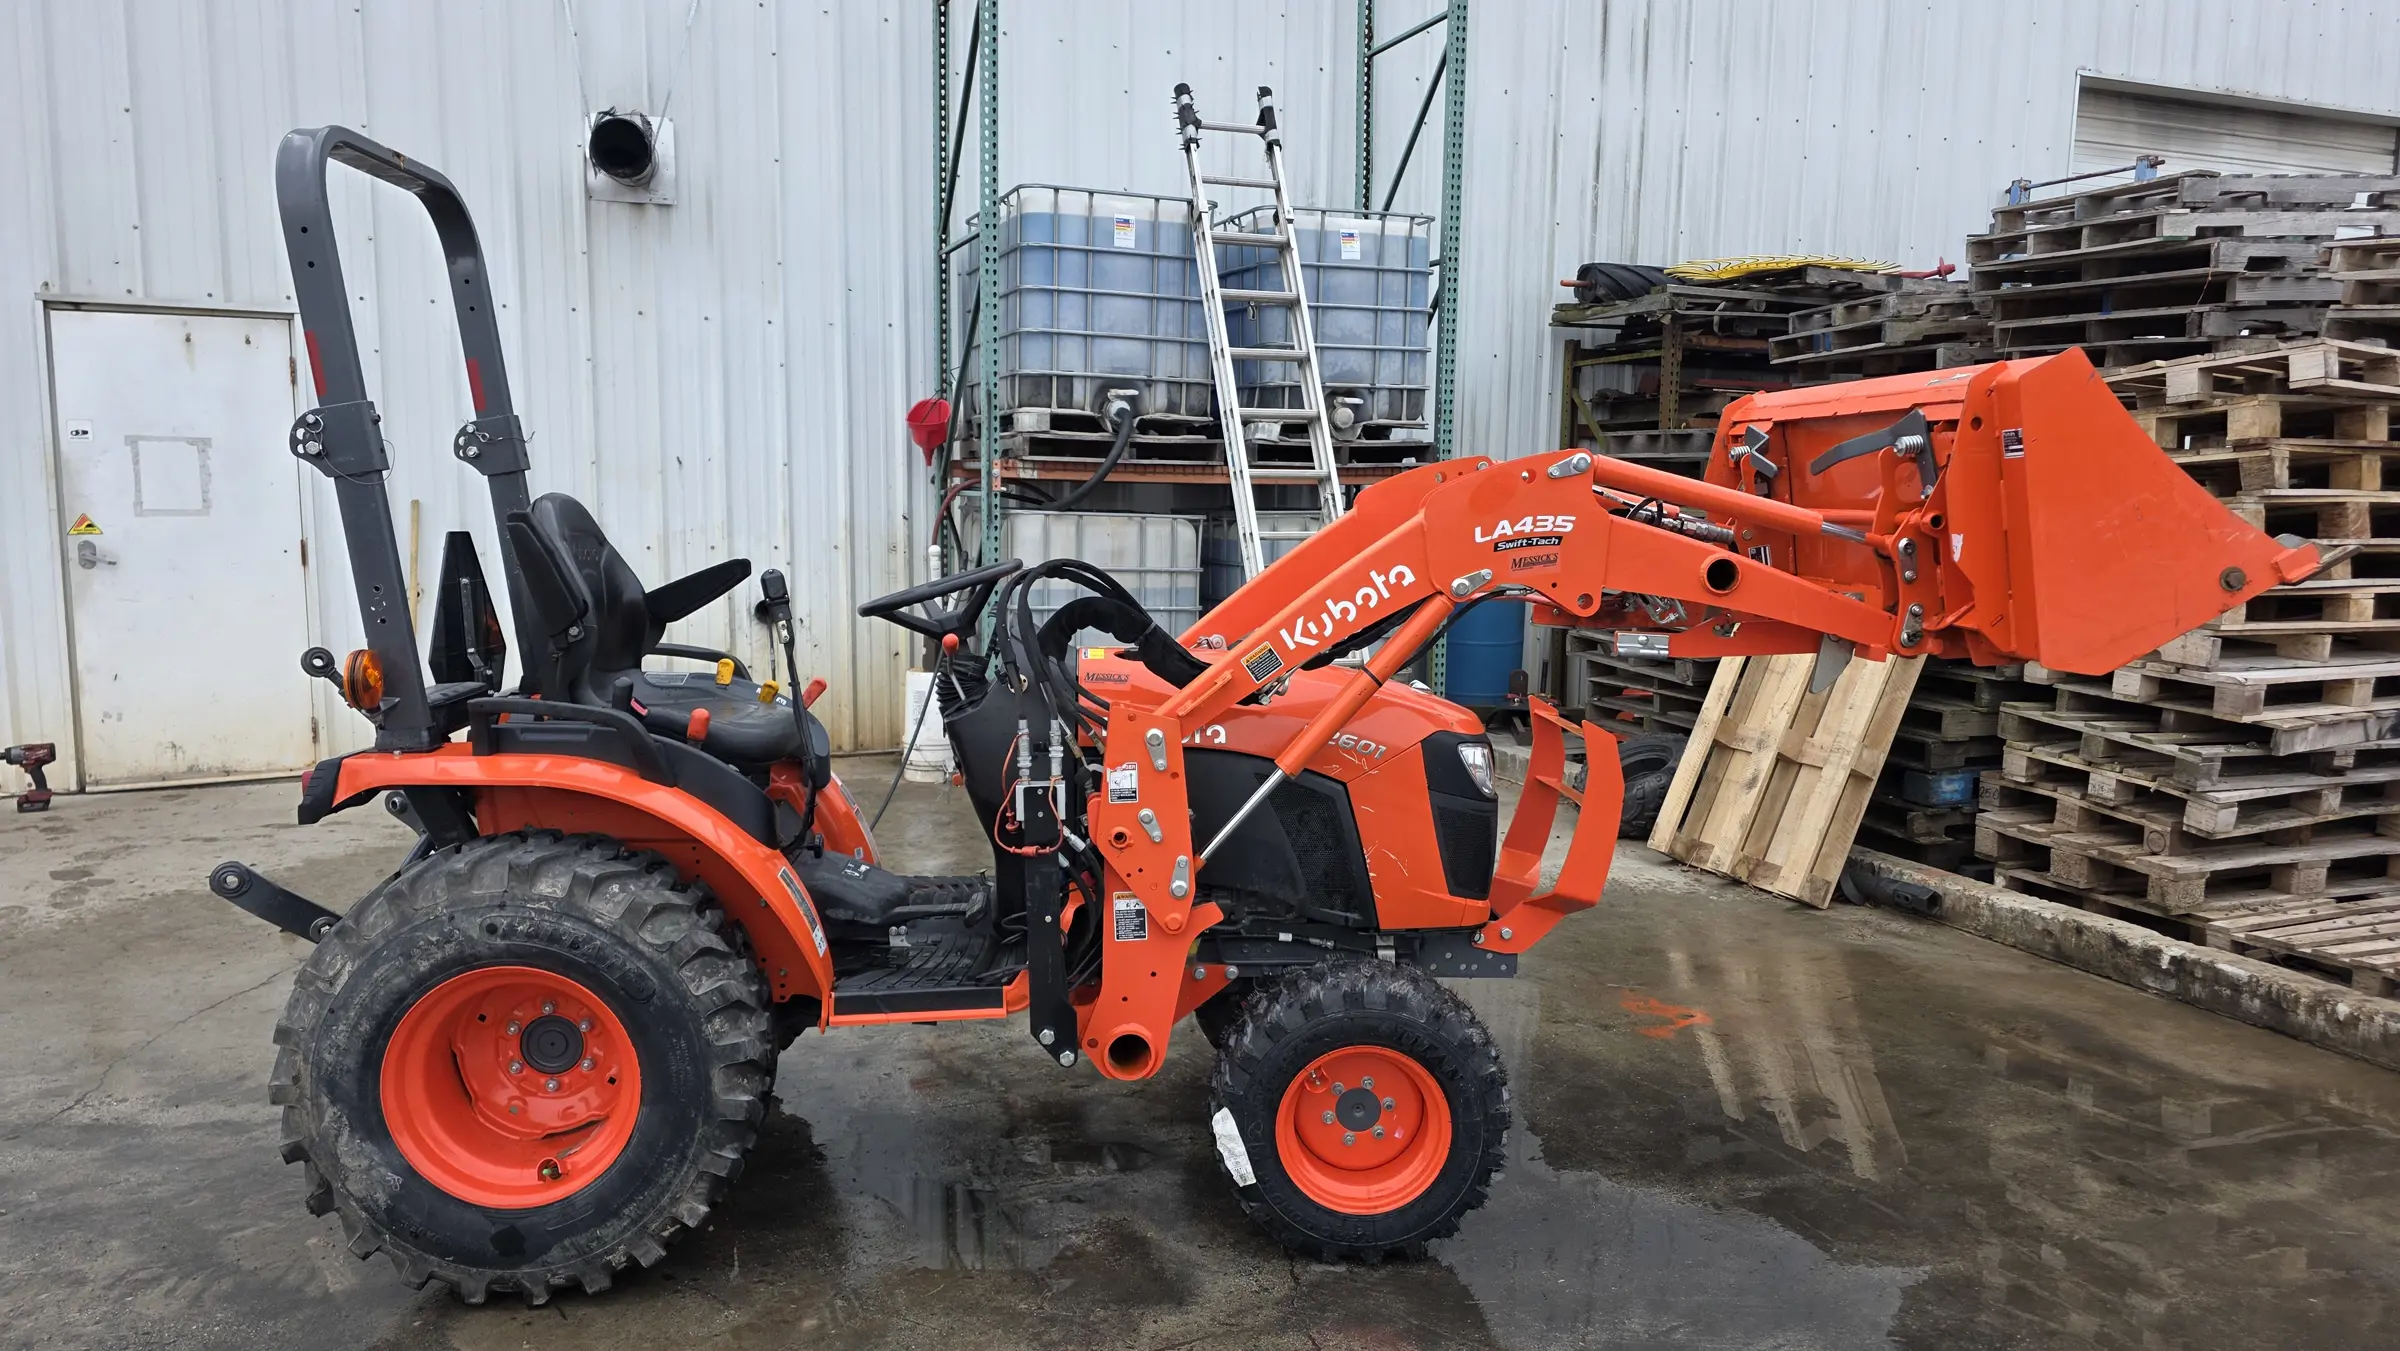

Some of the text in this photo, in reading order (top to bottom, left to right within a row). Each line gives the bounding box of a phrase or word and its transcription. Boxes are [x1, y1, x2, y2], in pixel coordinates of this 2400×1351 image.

[1474, 515, 1577, 543] LA435
[1496, 536, 1560, 551] Swift-Tach
[1511, 552, 1559, 569] MESSICK'S
[1279, 564, 1417, 651] Kubota
